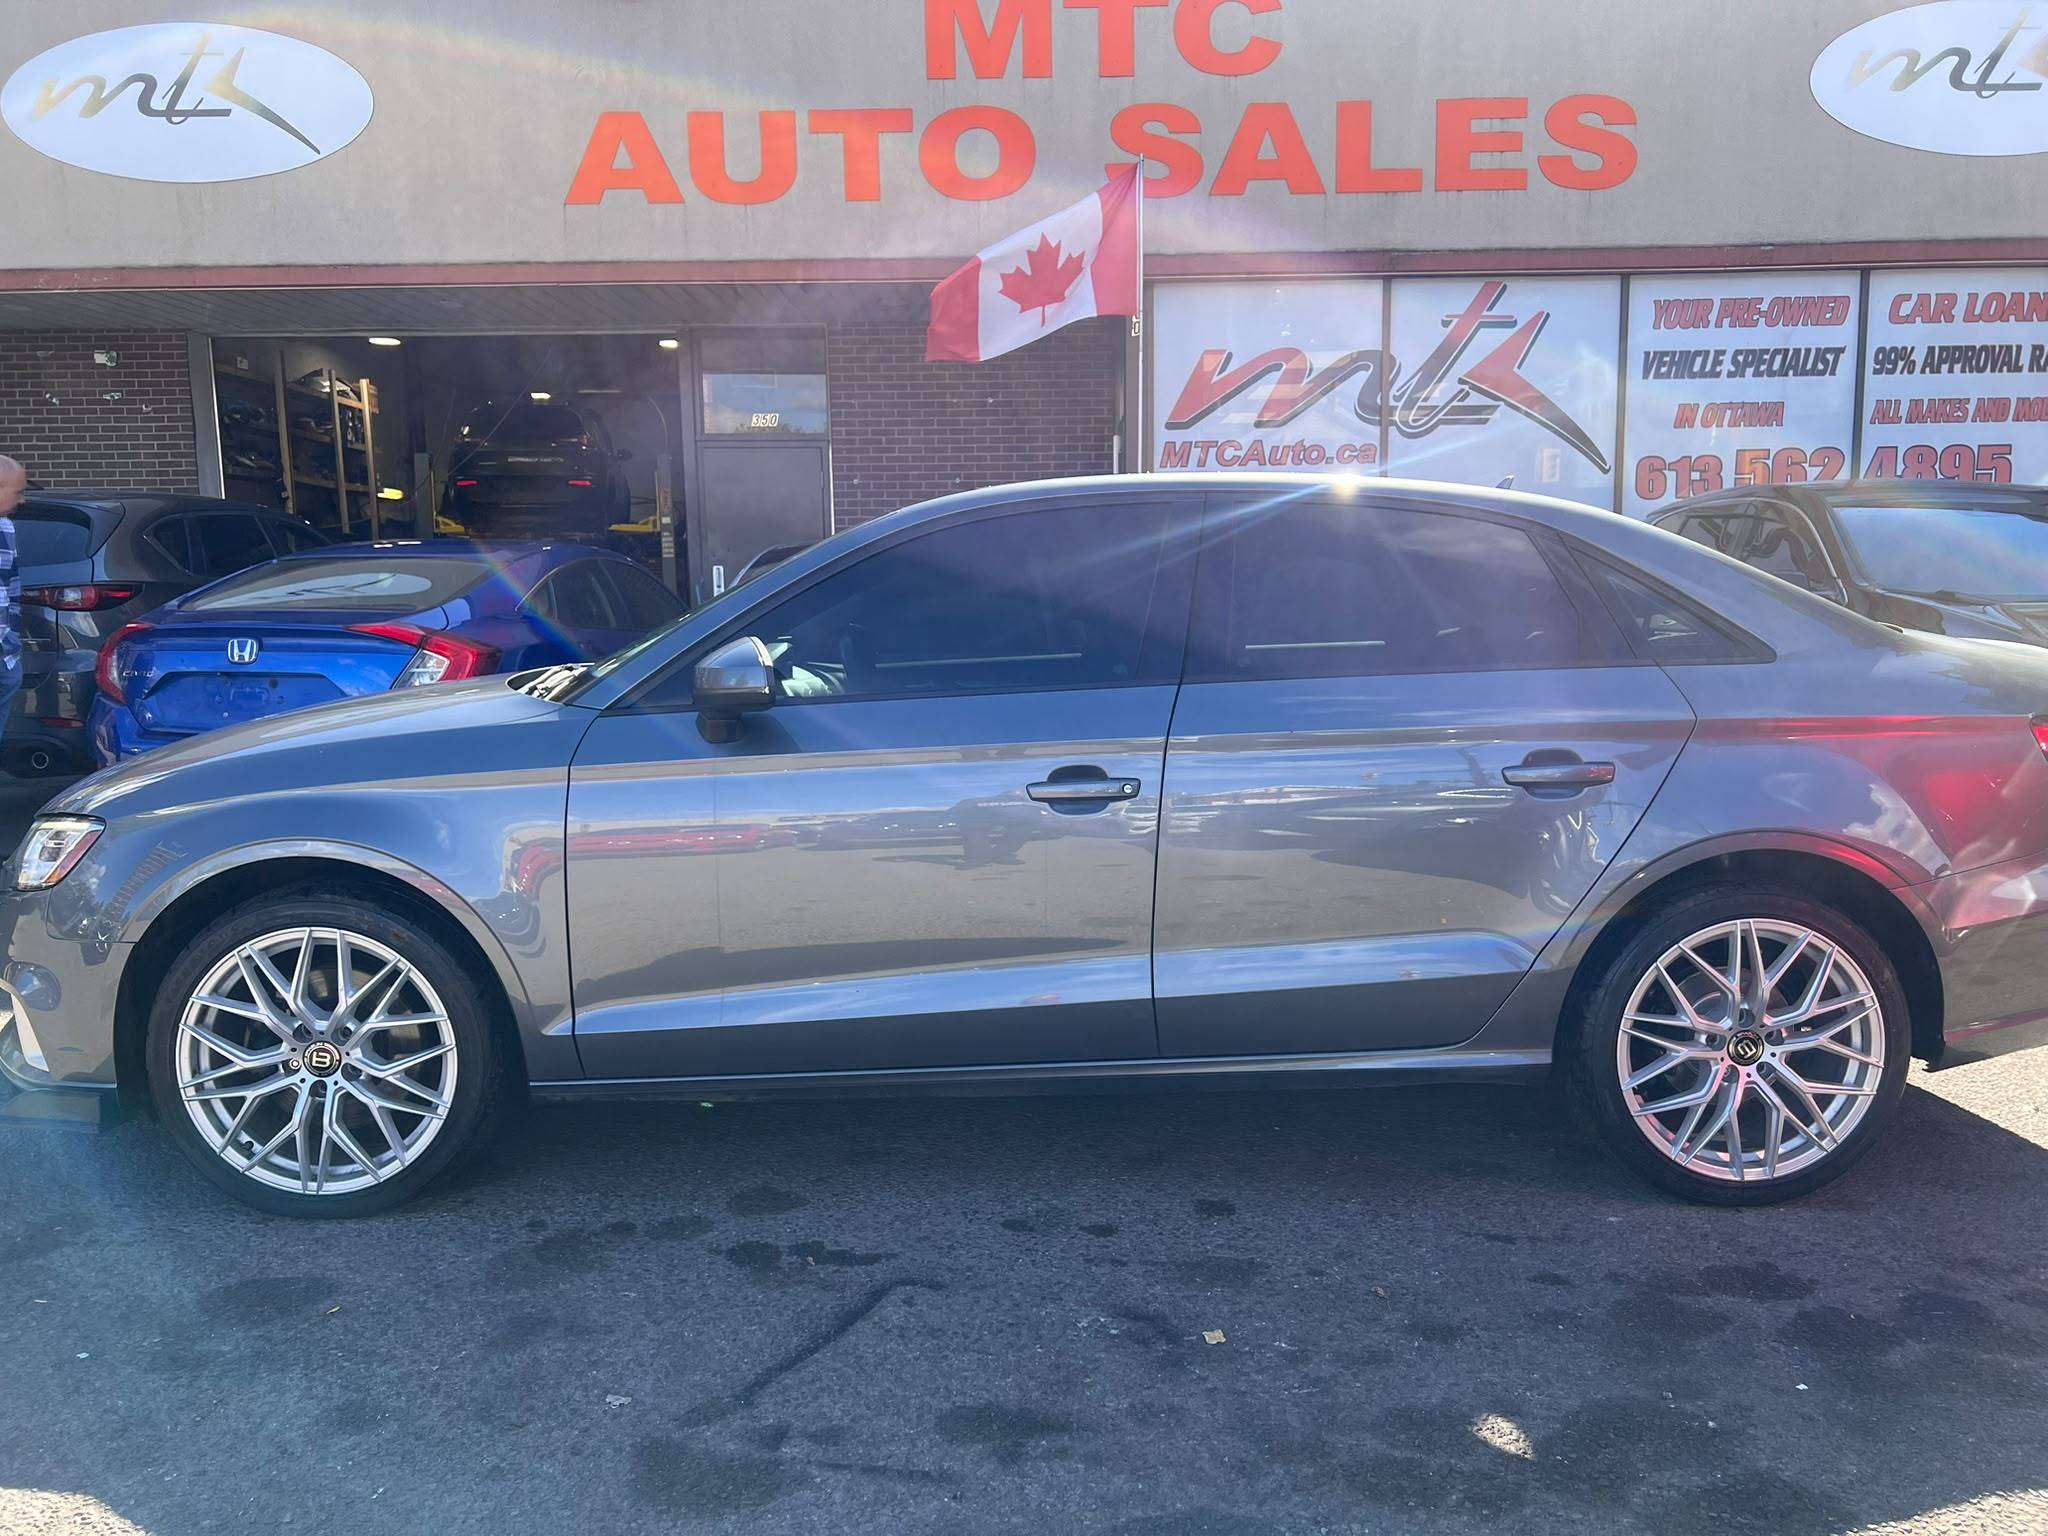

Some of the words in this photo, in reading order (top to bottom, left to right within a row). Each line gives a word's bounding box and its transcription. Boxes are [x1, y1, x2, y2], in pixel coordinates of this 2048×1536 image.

[925, 0, 1283, 79] MTC
[564, 105, 1037, 206] AUTO
[1104, 94, 1639, 198] SALES
[1652, 299, 1714, 330] YOUR
[1714, 295, 1851, 328] PRE-OWNED
[1887, 292, 1959, 325] CAR
[1642, 349, 1727, 380] VEHICLE
[1726, 345, 1847, 379] SPECIALIST
[1872, 345, 1917, 376] 99%
[1919, 344, 2025, 375] APPROVAL
[2027, 343, 2048, 374] R
[751, 413, 780, 428] 350
[1673, 403, 1699, 429] IN
[1700, 401, 1785, 428] OTTAWA
[1870, 399, 1902, 425] ALL
[1904, 397, 1971, 424] MAKES
[1970, 397, 2012, 423] AND
[1159, 438, 1378, 469] MTCAuto.ca
[1634, 454, 1724, 500] 613
[1733, 446, 1846, 489] 562
[1863, 443, 2013, 483] 4895
